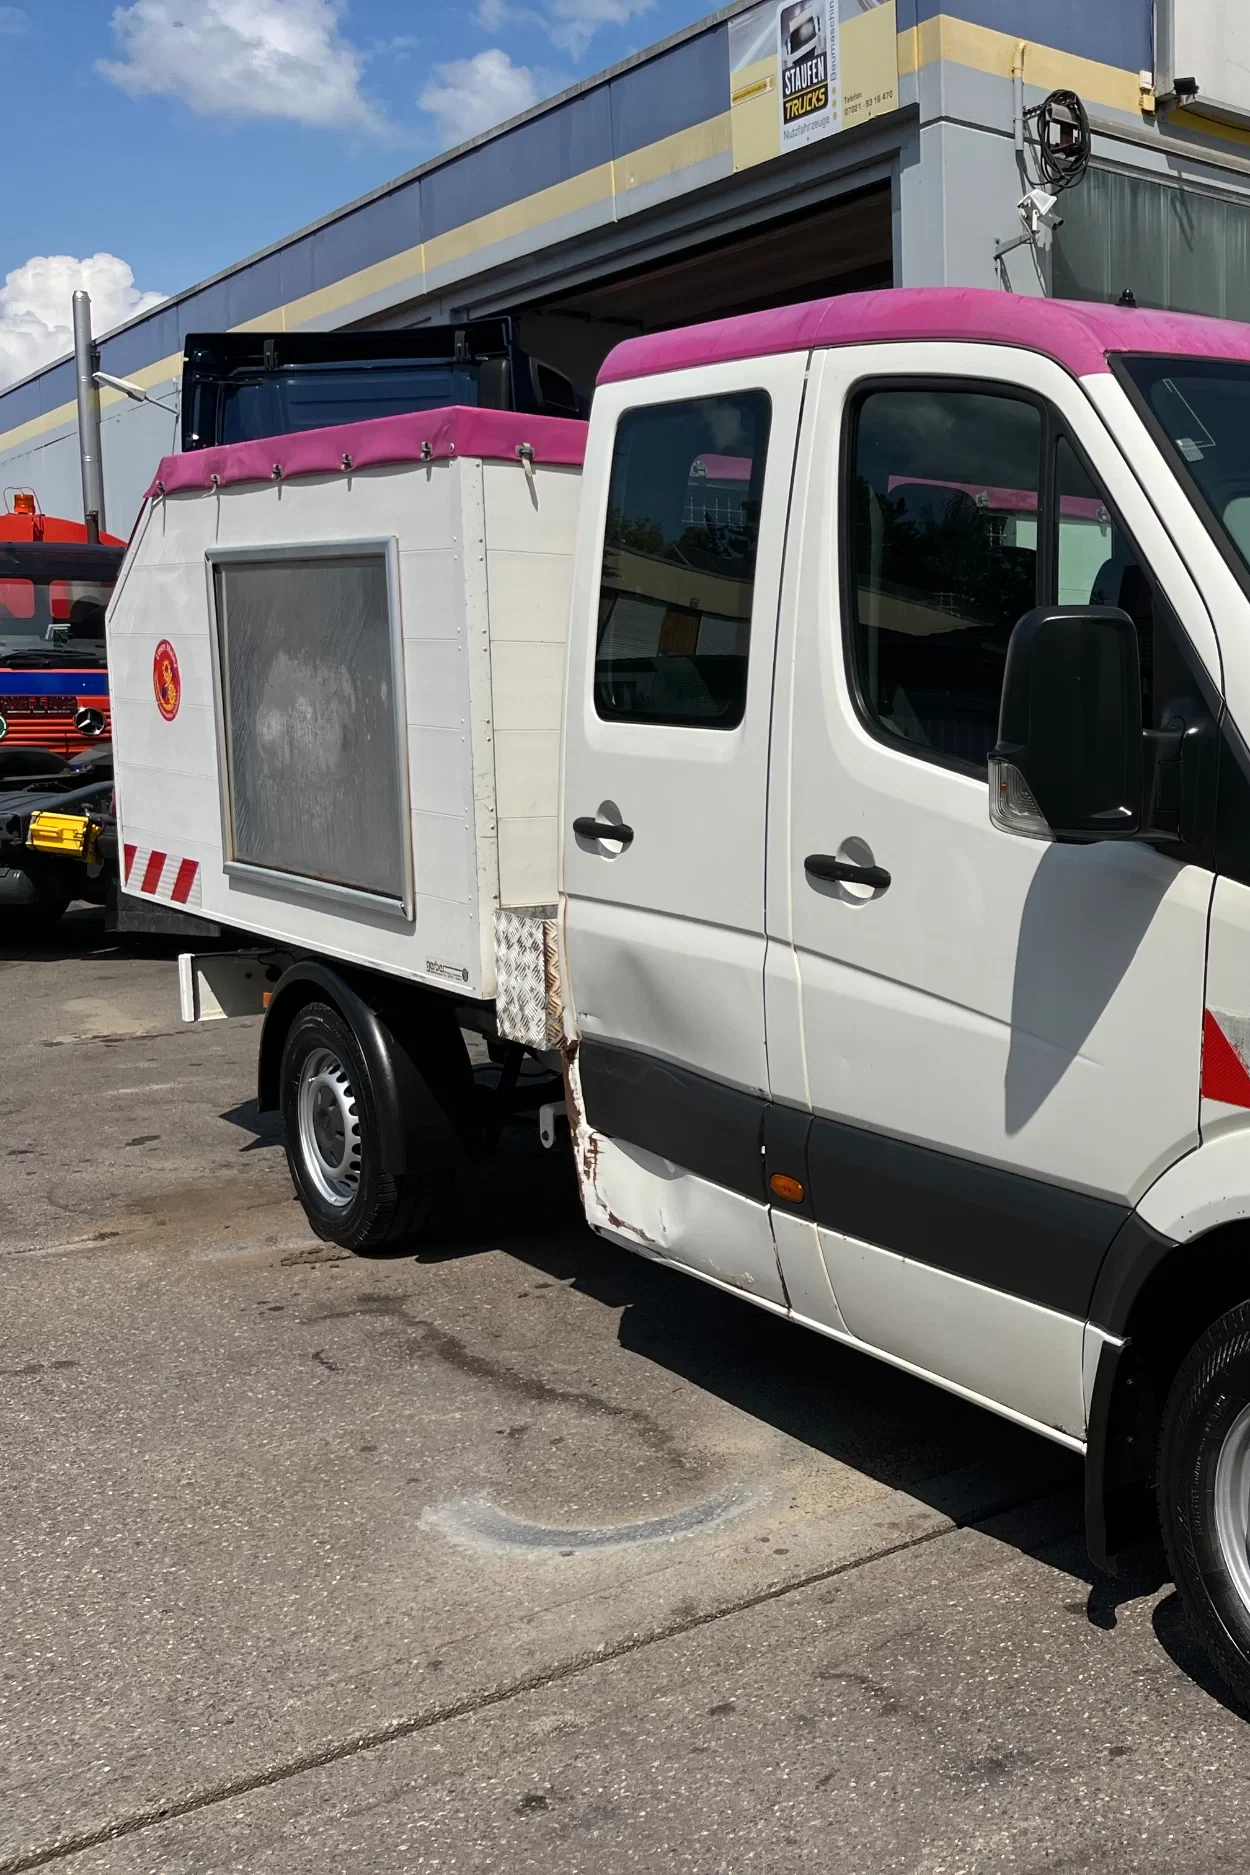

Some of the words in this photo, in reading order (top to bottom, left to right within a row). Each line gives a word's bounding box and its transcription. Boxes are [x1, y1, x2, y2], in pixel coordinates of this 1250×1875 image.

[785, 56, 825, 95] STAUFEN
[785, 88, 825, 120] TRUCKS
[882, 90, 894, 100] 470
[783, 115, 830, 140] Nutzfahrzeuge
